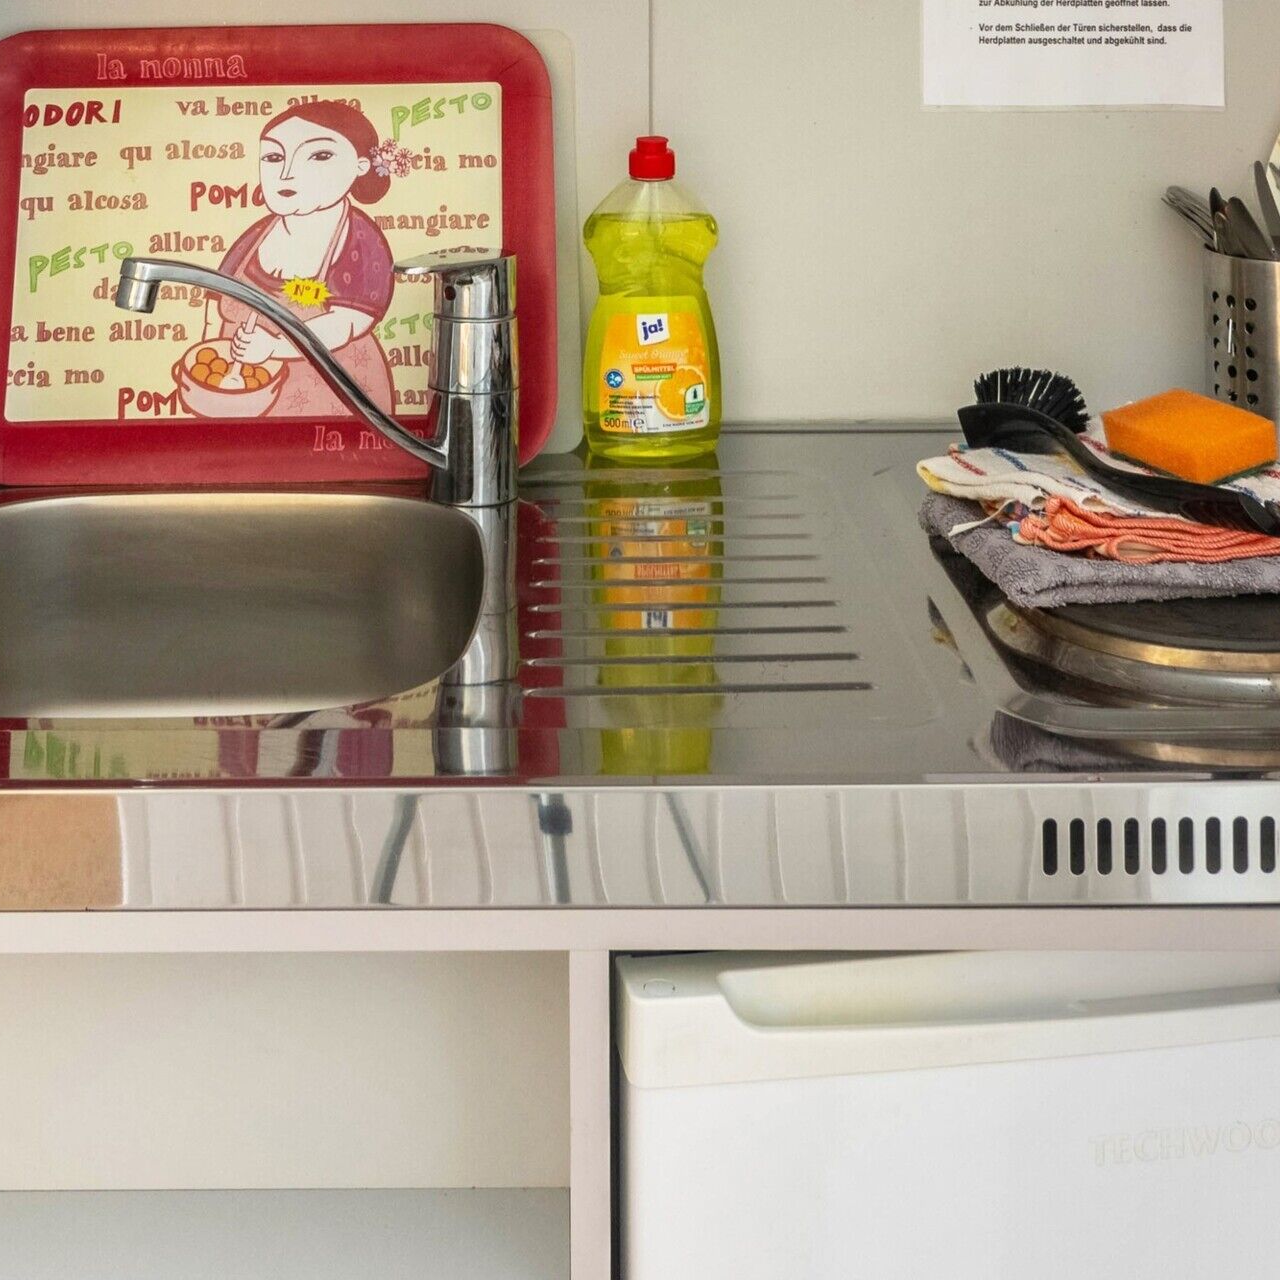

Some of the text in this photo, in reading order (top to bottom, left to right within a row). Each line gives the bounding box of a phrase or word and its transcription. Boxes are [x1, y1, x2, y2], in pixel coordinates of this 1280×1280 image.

[979, 0, 992, 7] zur
[979, 23, 1192, 34] Vor dem Schließen der Türen sicherstellen, dass die
[979, 36, 1168, 47] Herdplatten ausgeschaltet und abgekühlt sind.
[97, 53, 248, 80] la nonna
[22, 99, 122, 128] ODORI
[176, 99, 209, 116] va
[216, 96, 273, 116] bene
[391, 92, 492, 142] PESTO
[120, 139, 246, 170] qu alcosa
[459, 154, 498, 169] mo
[20, 190, 148, 221] qu alcosa
[374, 204, 490, 237] mangiare
[149, 230, 227, 254] allora
[29, 241, 133, 293] PESTO
[35, 321, 95, 342] bene
[109, 319, 188, 342] allora
[641, 318, 664, 341] ja!
[64, 369, 104, 384] mo
[313, 425, 345, 452] la
